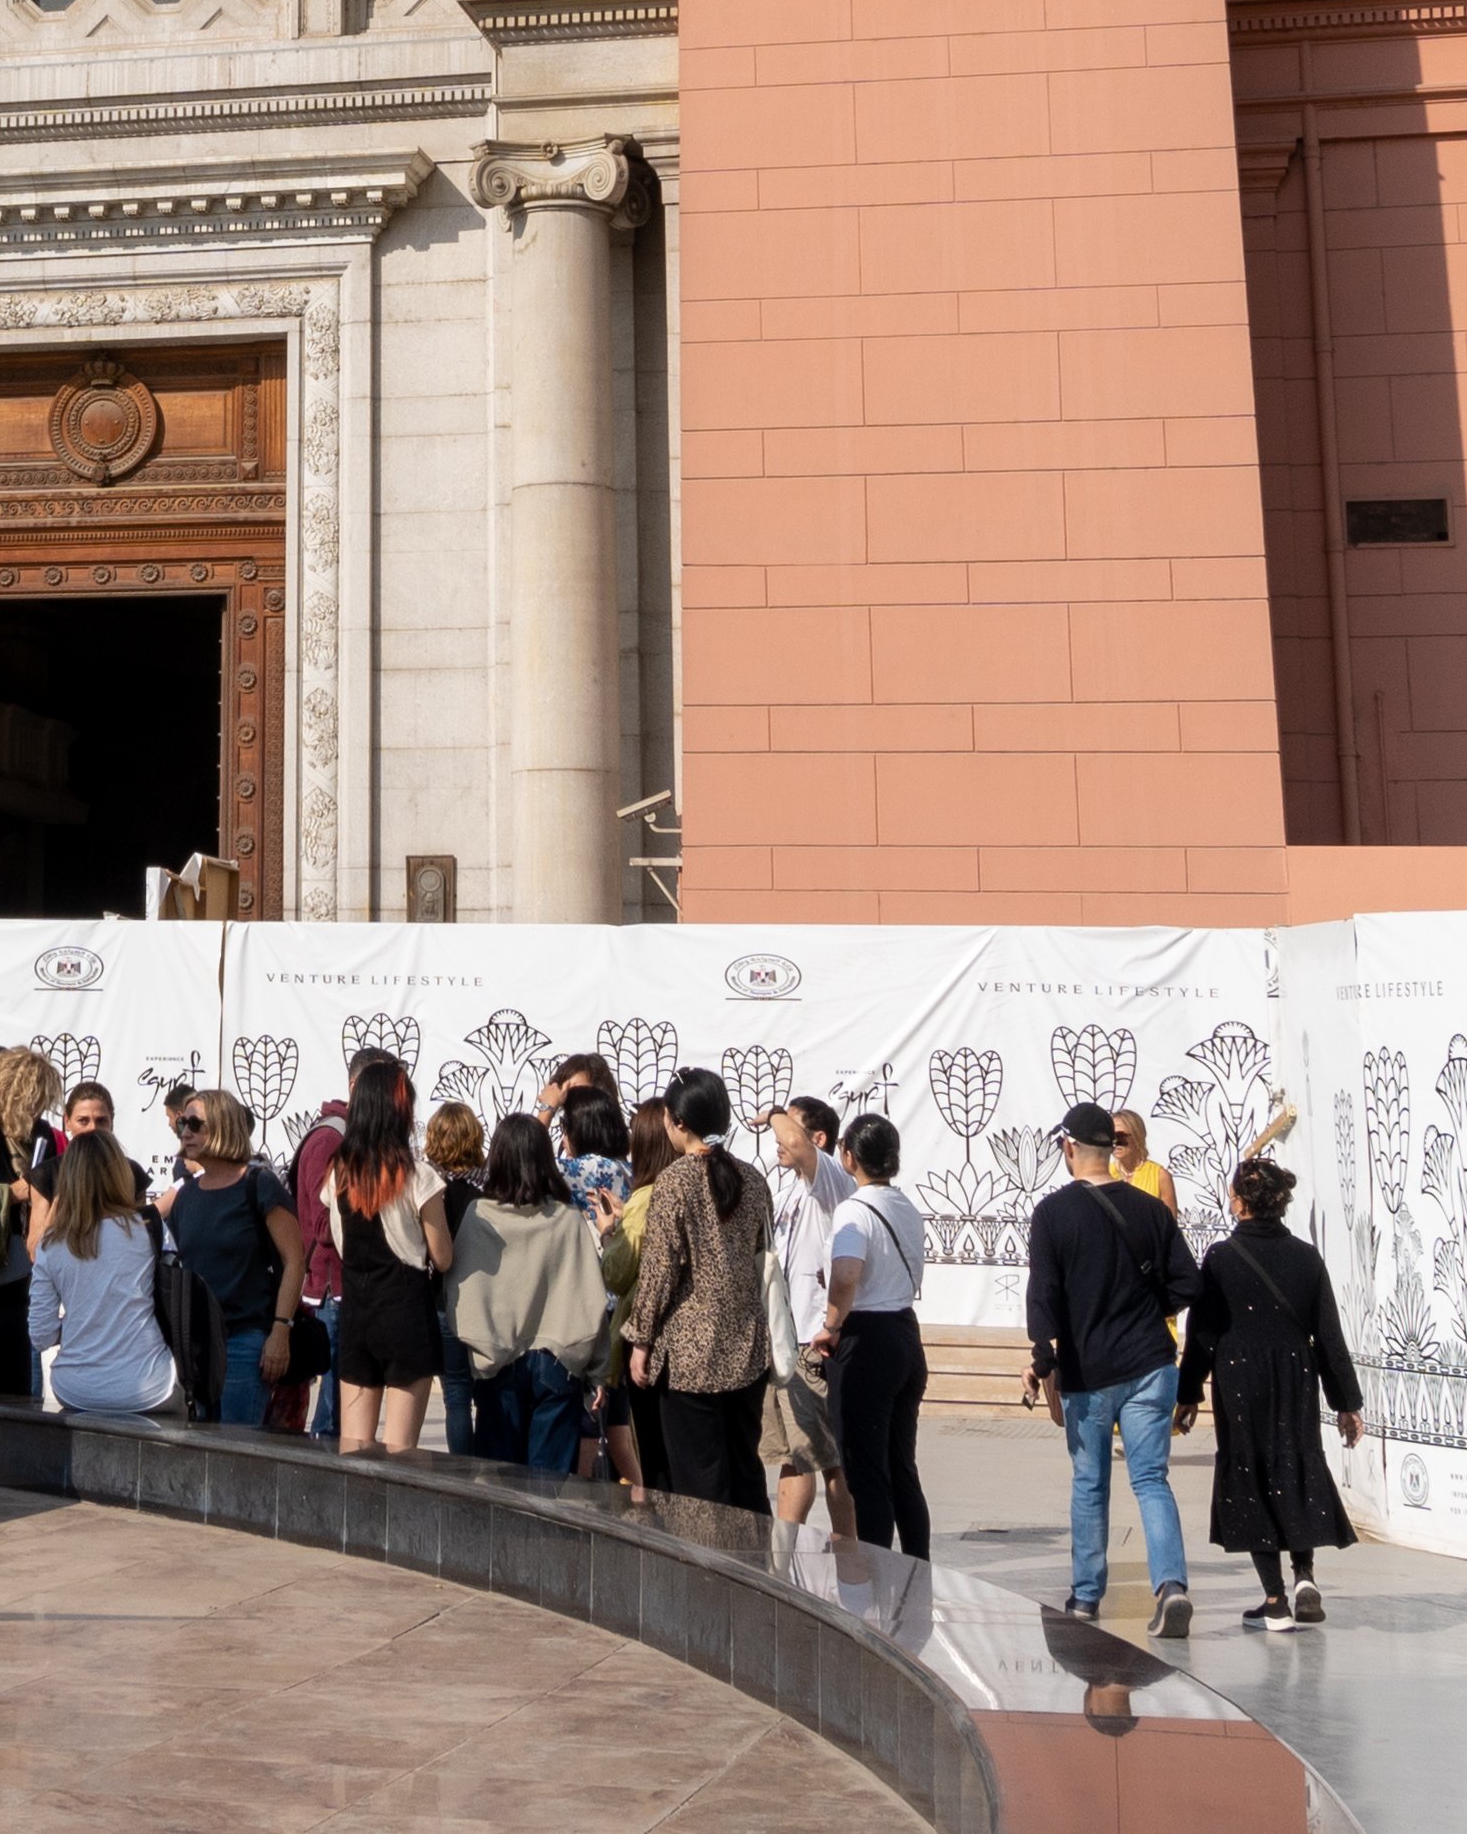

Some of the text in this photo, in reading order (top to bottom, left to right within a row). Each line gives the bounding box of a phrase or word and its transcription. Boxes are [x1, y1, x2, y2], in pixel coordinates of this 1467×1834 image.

[266, 973, 482, 987] VENTURE LIFESTYLE
[977, 982, 1219, 999] VENTURE LIFESTYLE
[1375, 981, 1443, 999] LIFESTYLE
[152, 1155, 174, 1164] EM
